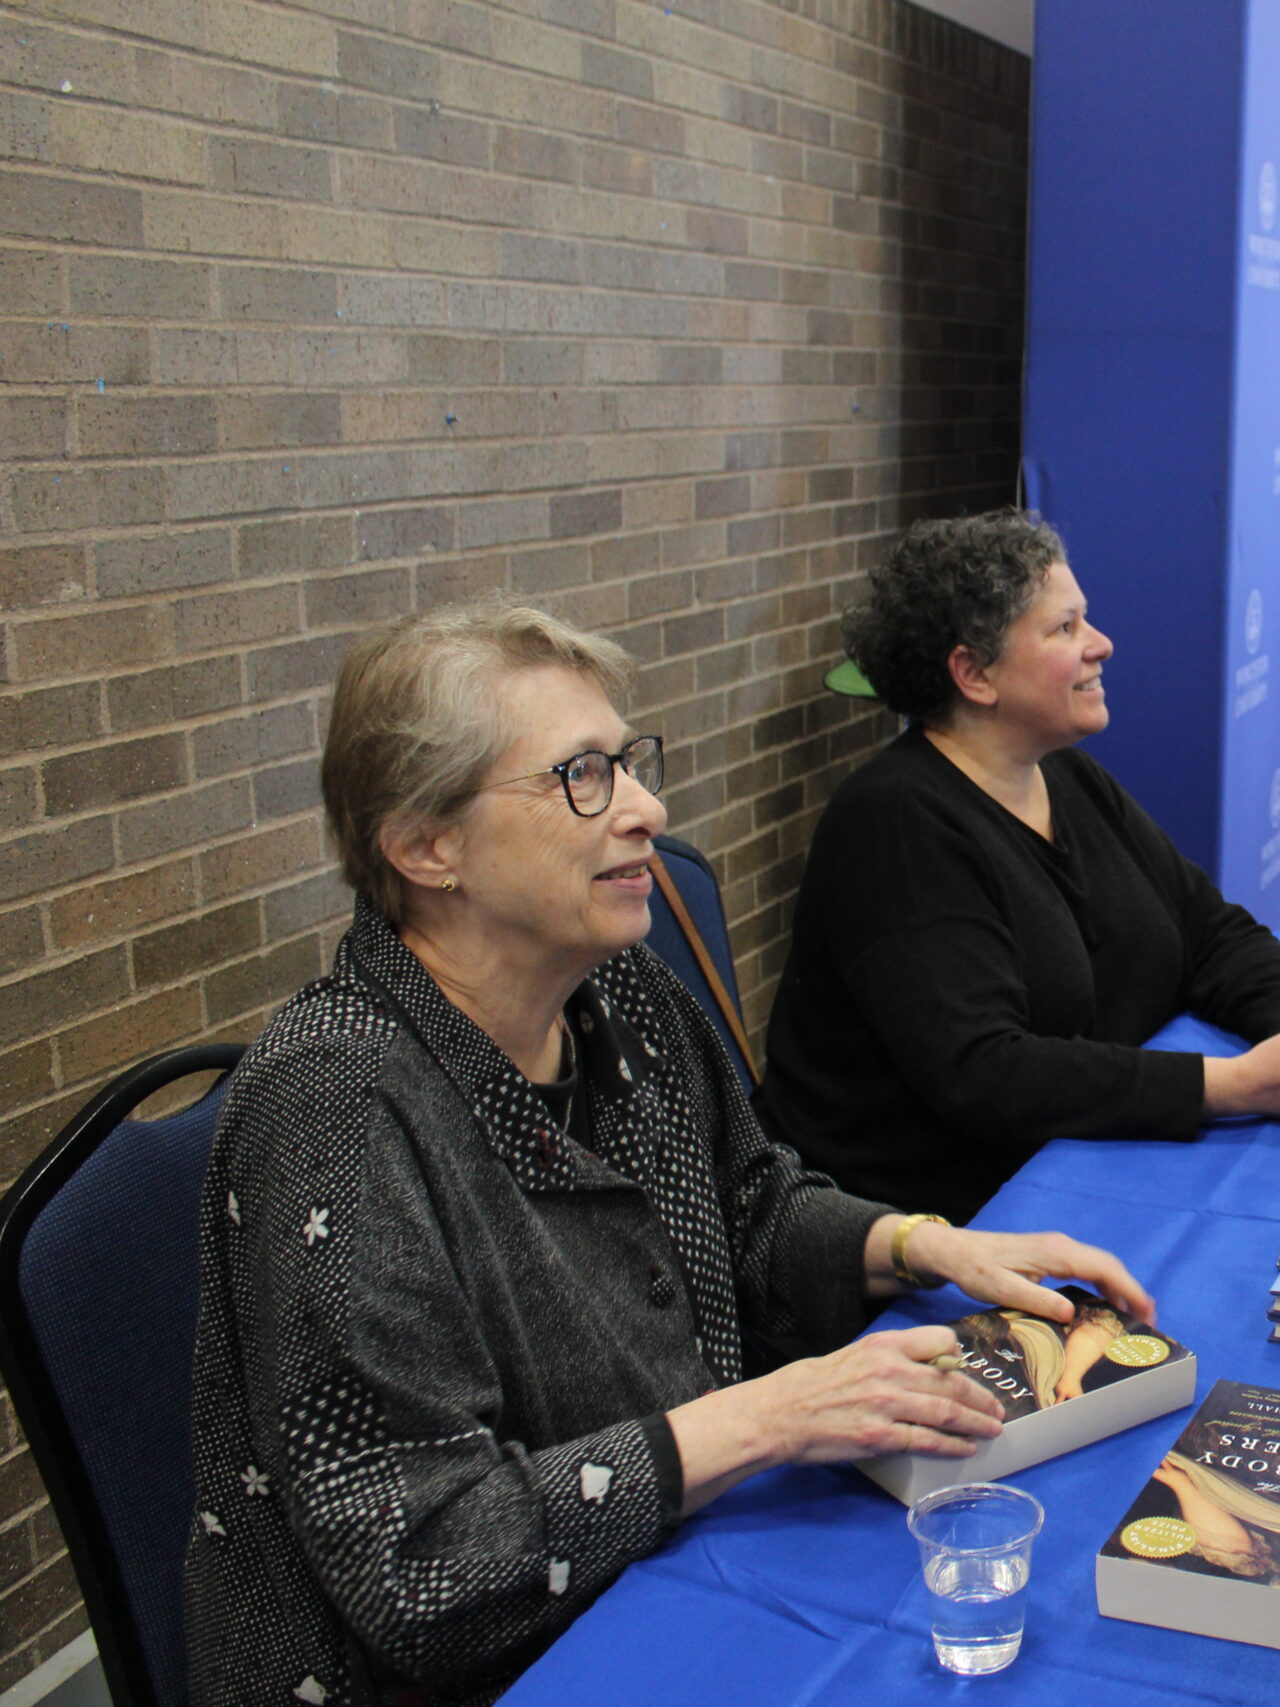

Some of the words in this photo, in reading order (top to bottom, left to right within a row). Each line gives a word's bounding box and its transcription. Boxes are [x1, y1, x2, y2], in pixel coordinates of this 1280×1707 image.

[958, 1343, 1034, 1400] ABODY
[1134, 1524, 1192, 1542] PULITZER
[1151, 1520, 1186, 1533] PRIZE
[1130, 1531, 1183, 1553] FINALIST
